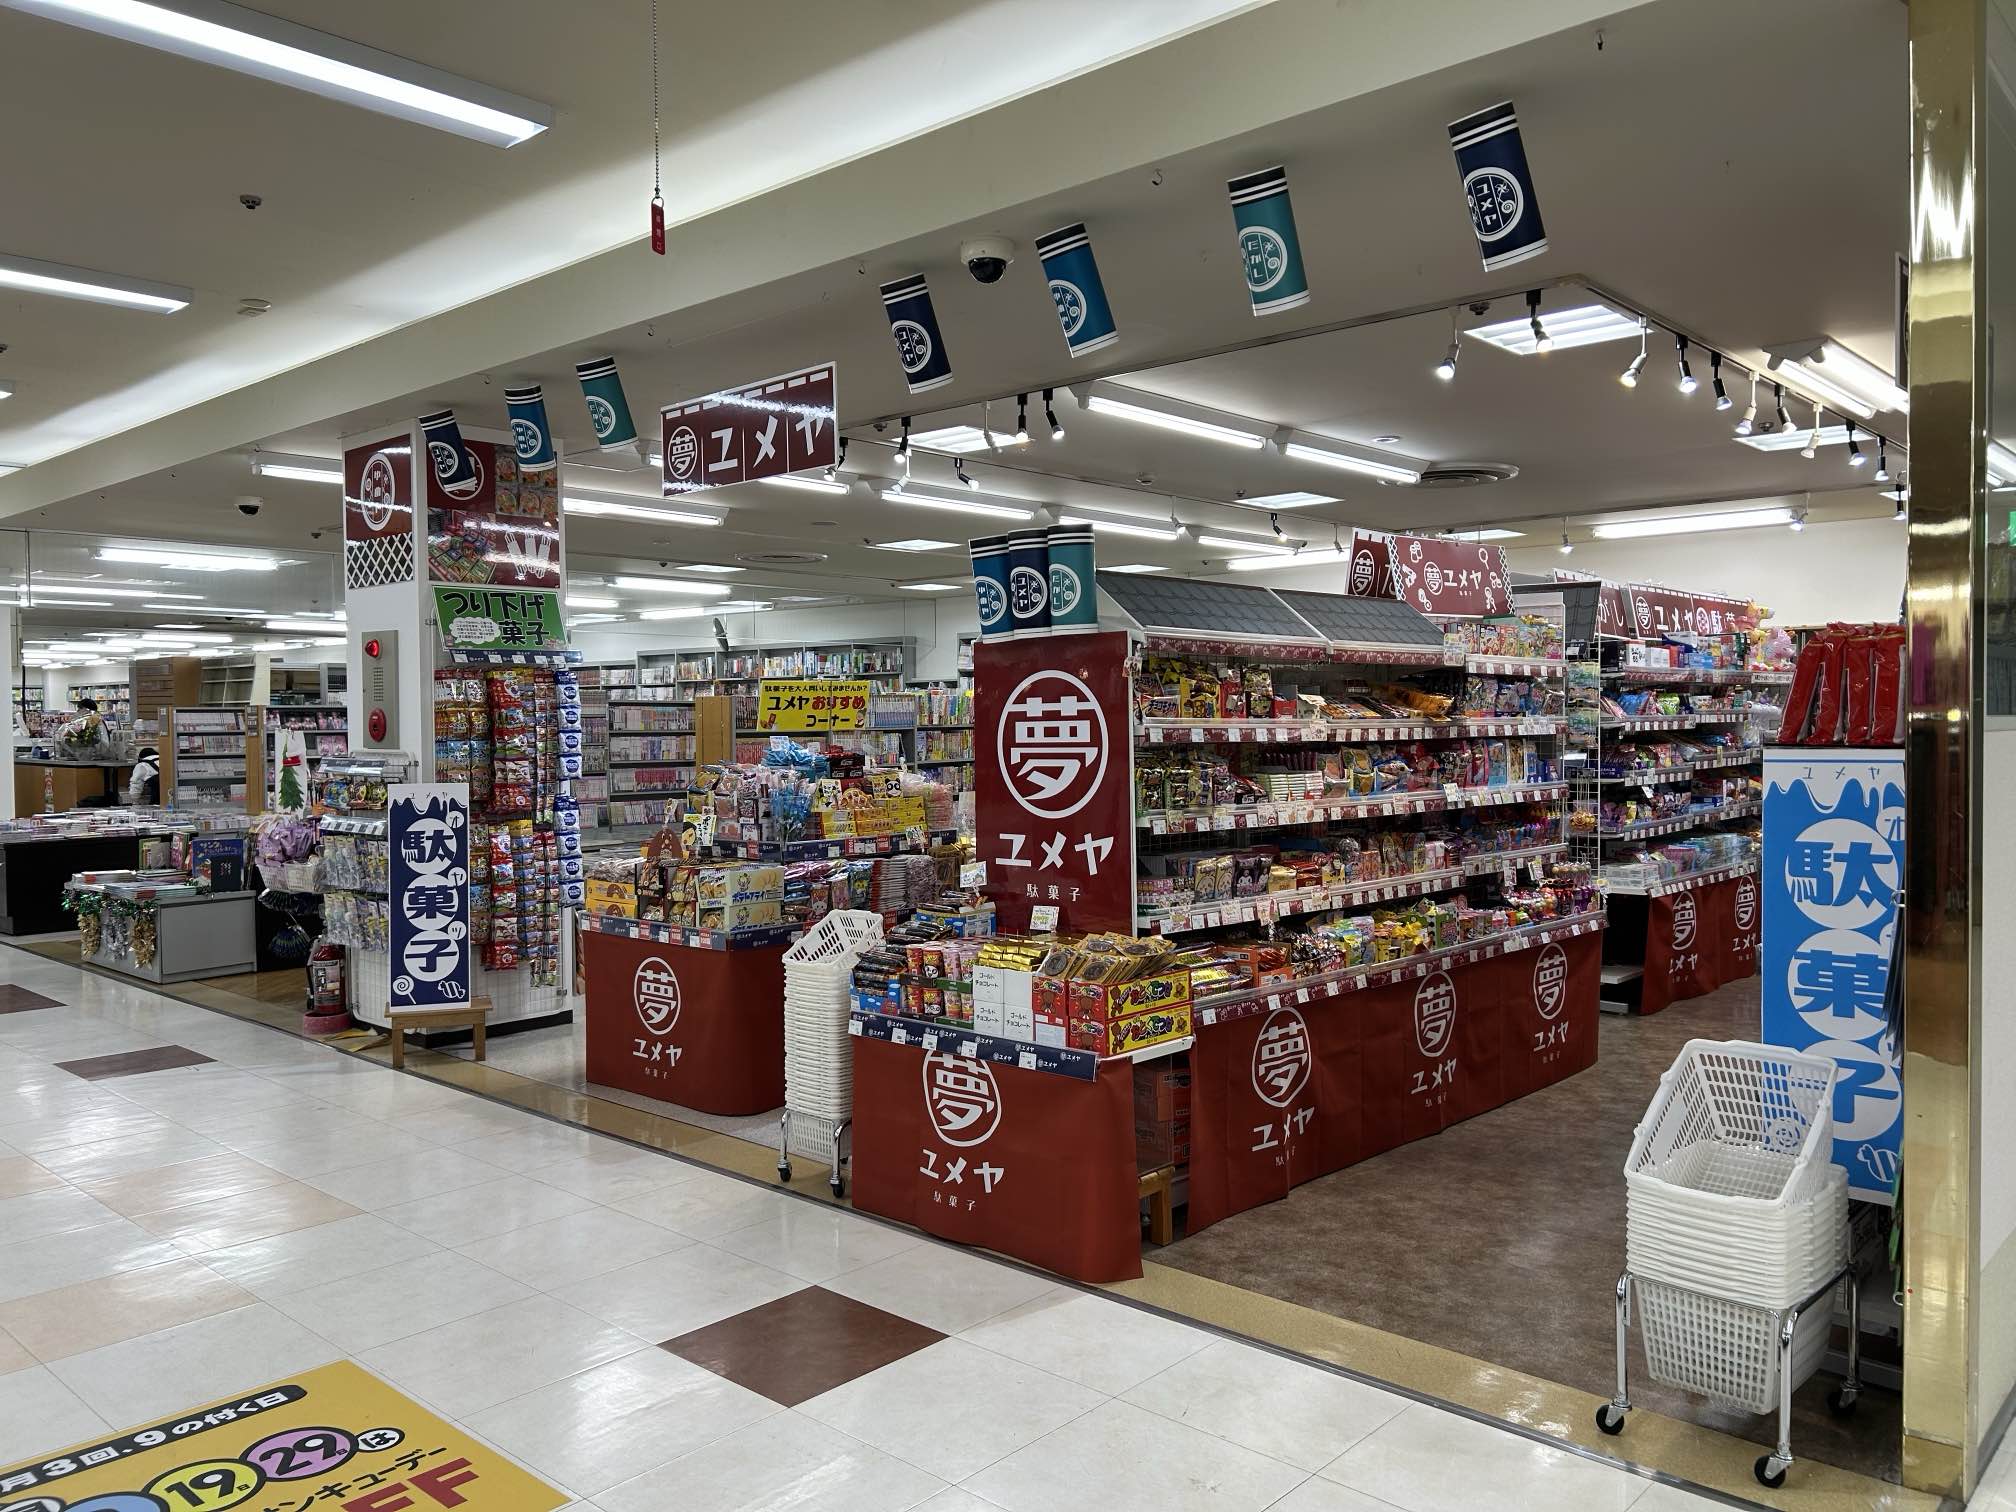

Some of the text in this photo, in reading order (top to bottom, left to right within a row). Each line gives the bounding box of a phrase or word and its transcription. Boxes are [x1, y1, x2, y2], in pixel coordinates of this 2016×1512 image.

[671, 414, 825, 475] 夢 ユメヤ
[1444, 568, 1482, 590] ユメヤ
[441, 592, 545, 620] つり下げ
[498, 619, 549, 646] 菓子
[767, 695, 866, 711] ユメヤおすすめ
[806, 714, 850, 728] コーナー
[1007, 696, 1099, 800] 夢
[1802, 766, 1880, 781] ユメヤ
[996, 832, 1114, 876] ユメヤ
[402, 830, 458, 973] 駄菓子
[1026, 883, 1081, 902] 駄菓子
[638, 969, 677, 1024] 夢
[1537, 955, 1567, 1013] 夢
[1417, 983, 1453, 1050] 夢
[1533, 1020, 1569, 1052] ユメヤ
[633, 1038, 683, 1067] ユメヤ
[1259, 1021, 1308, 1099] 夢
[926, 1051, 995, 1130] 夢
[1411, 1058, 1457, 1094] ユメヤ
[1252, 1106, 1315, 1152] ユメヤ
[919, 1148, 1005, 1193] ユメヤ
[359, 1431, 396, 1449] は
